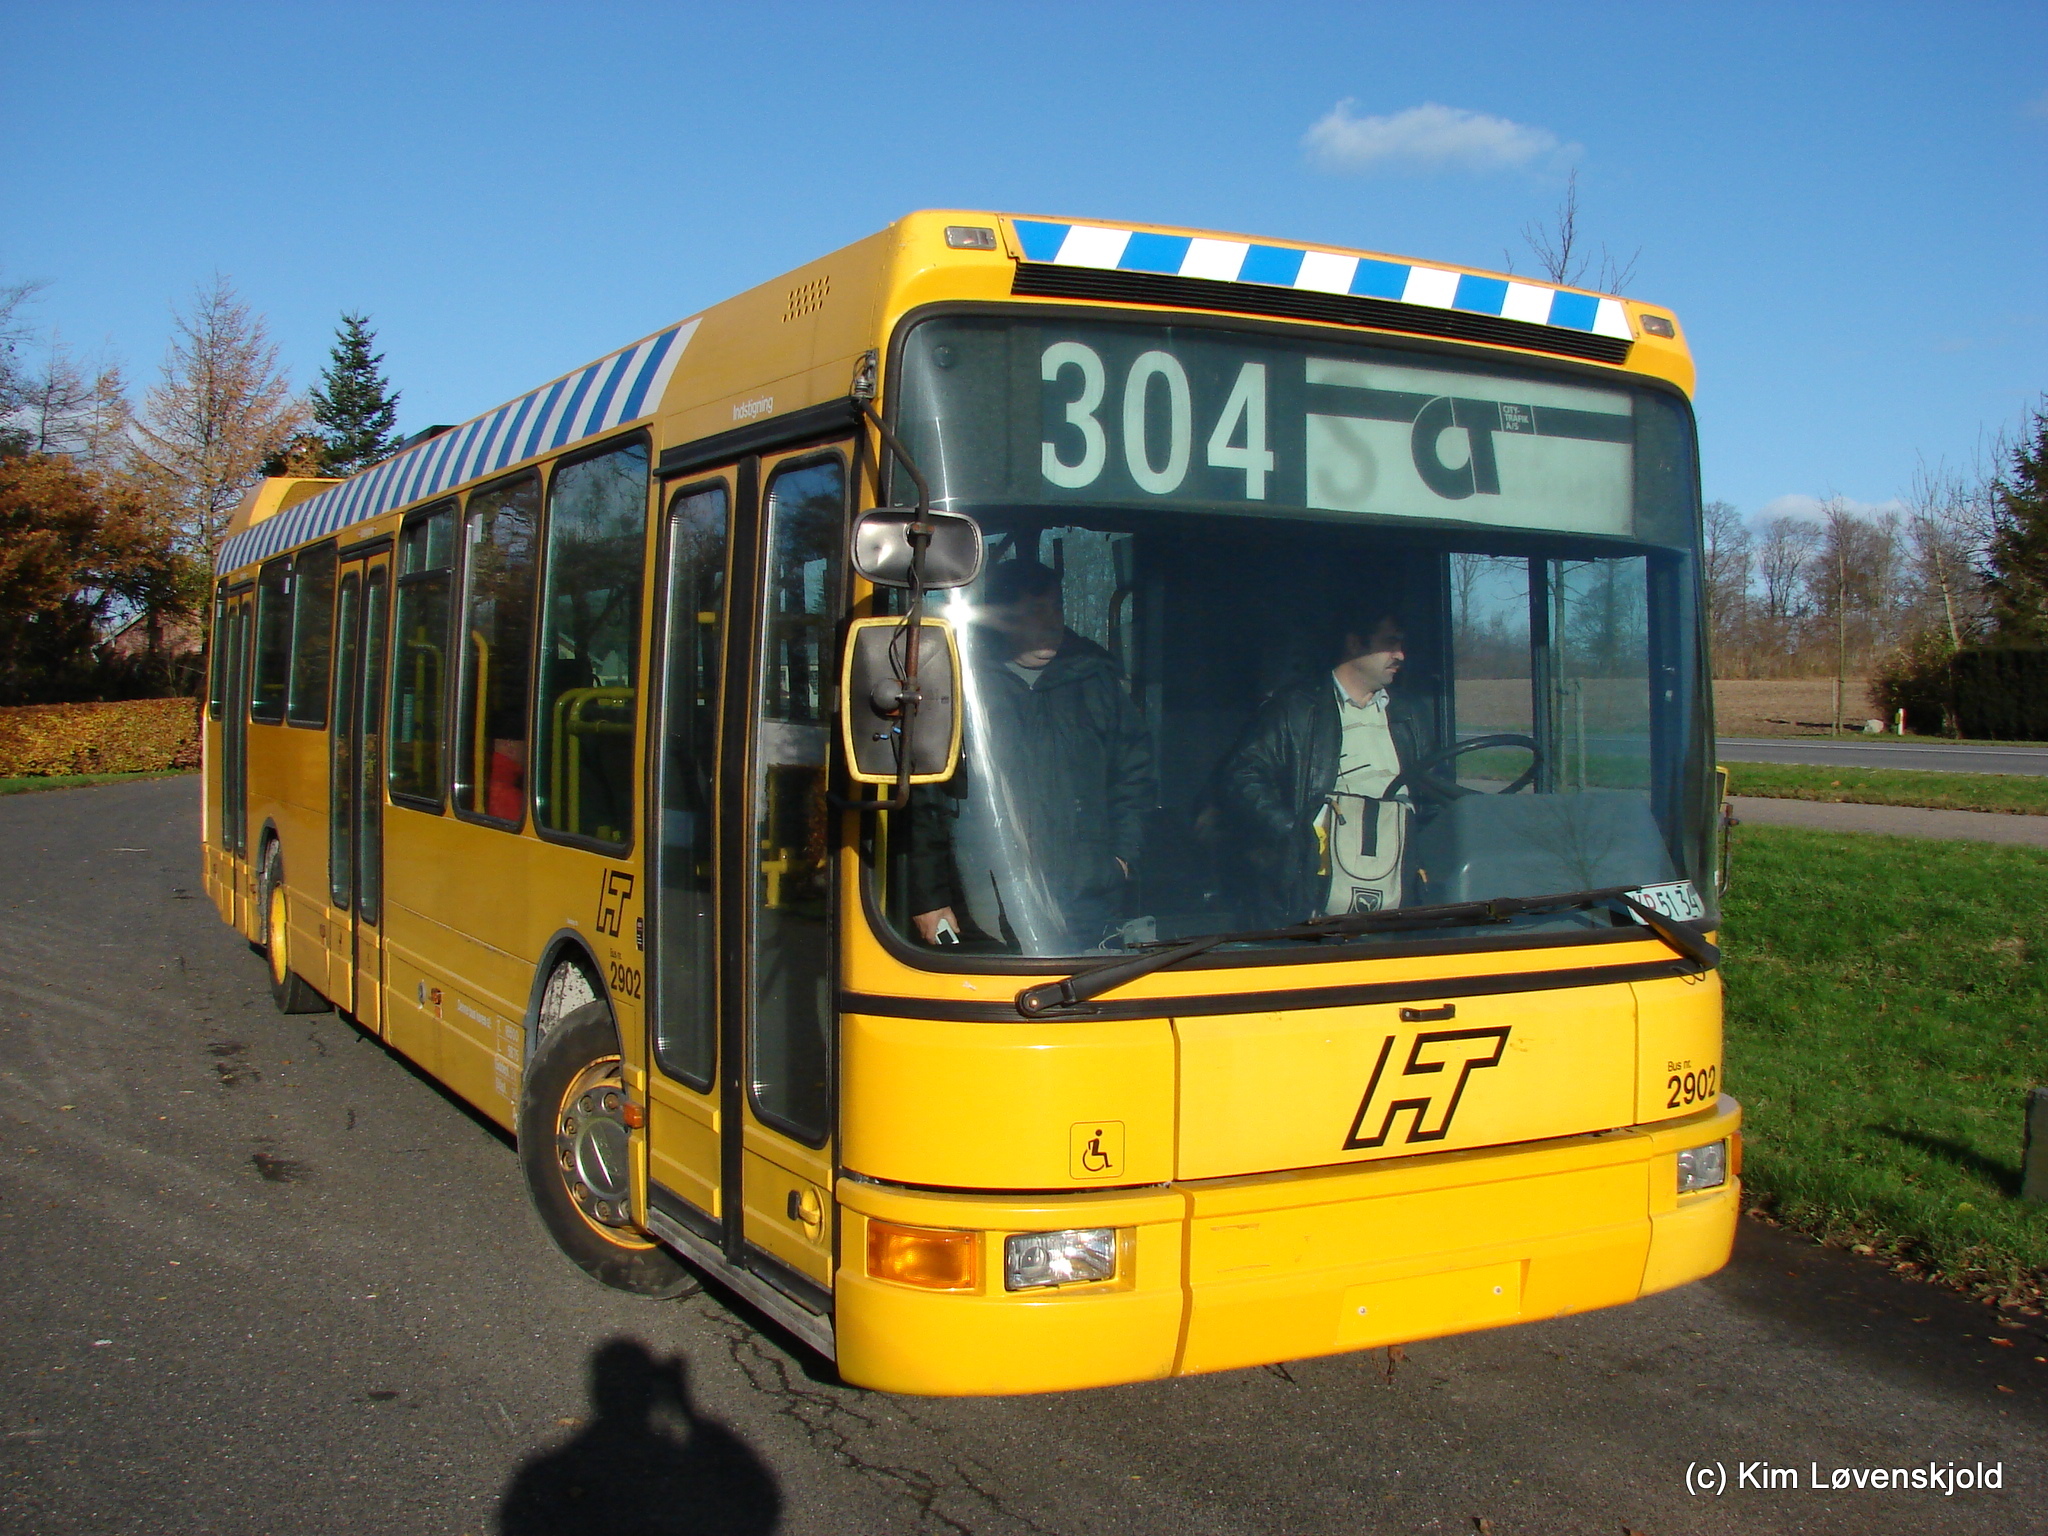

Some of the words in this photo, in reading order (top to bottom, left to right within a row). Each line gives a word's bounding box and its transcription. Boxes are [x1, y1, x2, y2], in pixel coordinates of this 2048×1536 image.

[733, 395, 774, 421] Indstigning
[1041, 341, 1274, 501] 304
[1503, 405, 1520, 414] CITY-
[1504, 413, 1530, 424] TRAFIK
[1506, 421, 1519, 430] A/S
[596, 868, 635, 938] HT
[1656, 890, 1680, 918] 51
[1675, 887, 1702, 916] 34
[610, 961, 641, 1000] 2902
[1667, 1060, 1682, 1073] Bus
[1683, 1060, 1692, 1069] nr.
[1341, 1025, 1513, 1151] HT
[1666, 1065, 1716, 1109] 2902
